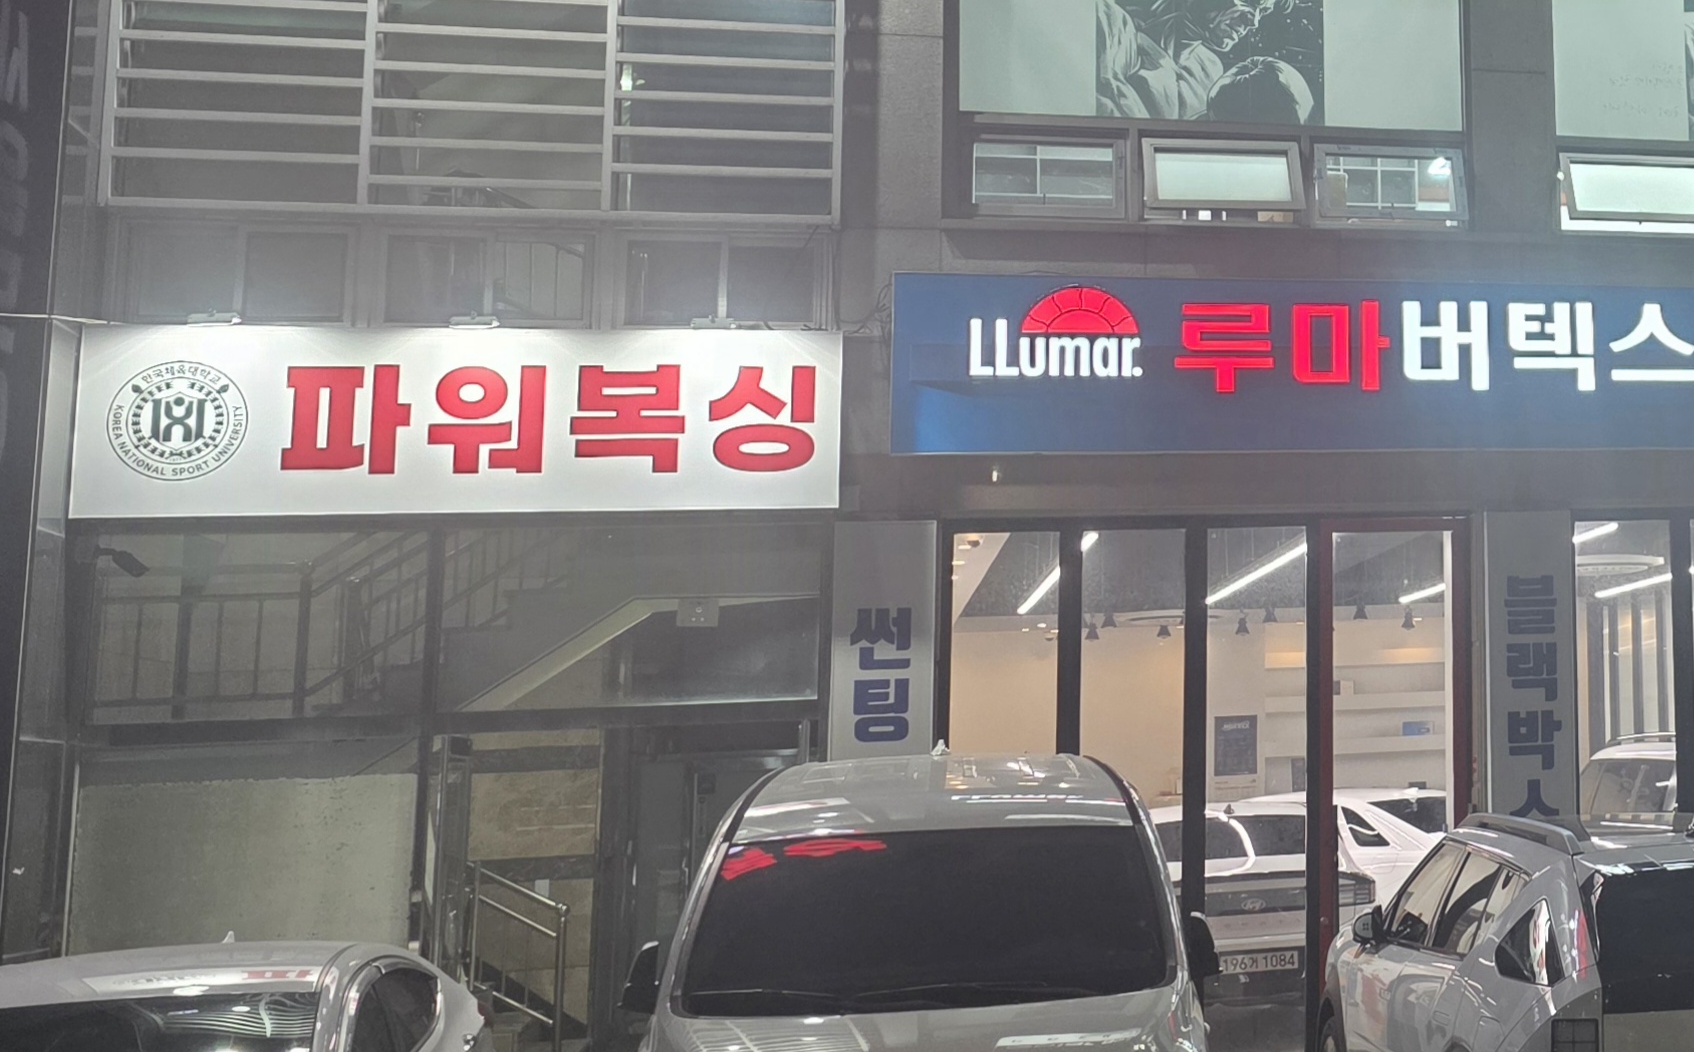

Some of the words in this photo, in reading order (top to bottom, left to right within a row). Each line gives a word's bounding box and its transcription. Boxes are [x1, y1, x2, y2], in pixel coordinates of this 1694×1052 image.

[112, 404, 126, 440] KOREA
[211, 405, 244, 463] UNIVERSITY
[279, 363, 817, 476] 파워복싱
[117, 441, 167, 476] NATIONAL
[171, 459, 211, 476] SPORT
[850, 606, 912, 743] 썬팅
[1262, 952, 1296, 969] 1084
